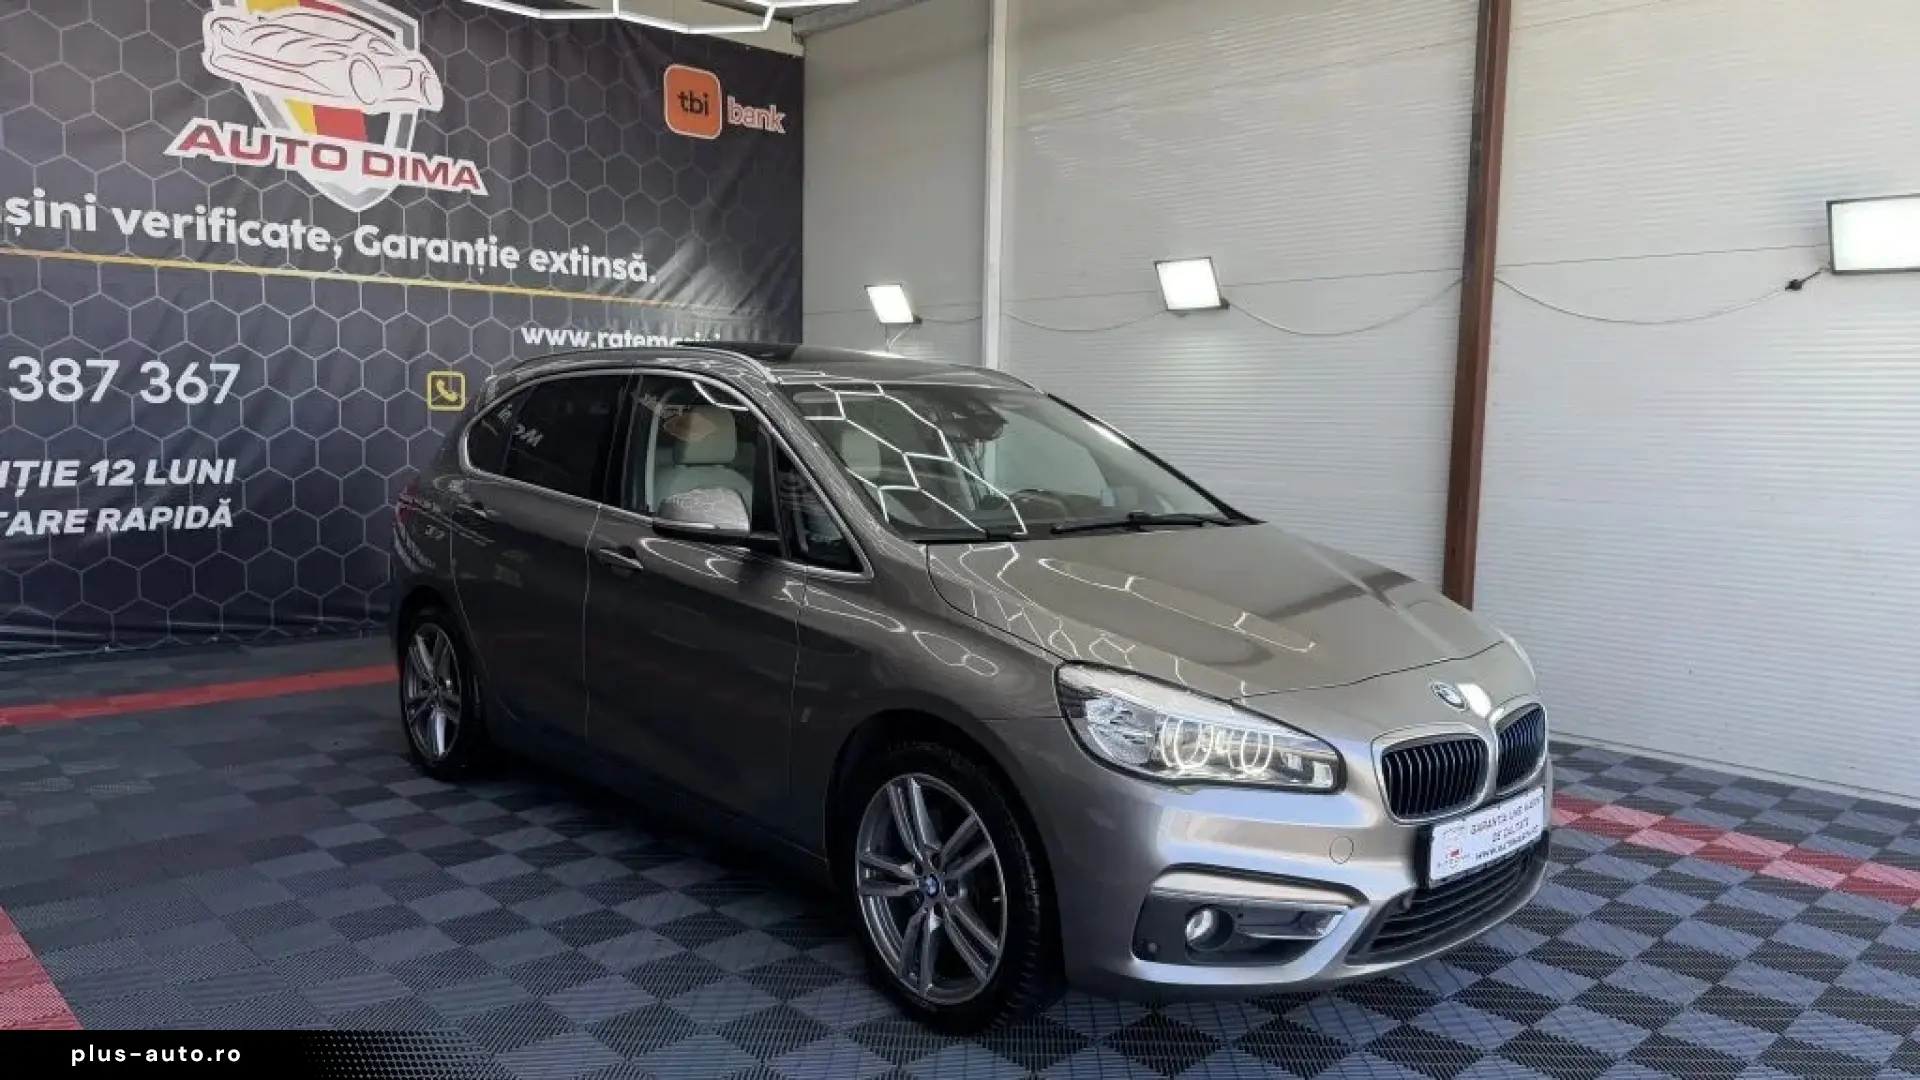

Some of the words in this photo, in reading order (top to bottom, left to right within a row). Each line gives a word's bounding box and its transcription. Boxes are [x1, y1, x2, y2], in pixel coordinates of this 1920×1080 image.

[676, 89, 710, 117] tbi
[726, 95, 787, 134] bank
[177, 123, 348, 172] AUTO
[361, 148, 481, 190] DIMA
[0, 187, 97, 236] șini
[111, 203, 342, 260] verificate,
[354, 224, 520, 276] Garanție
[528, 245, 657, 283] extinsă.
[521, 327, 721, 348] www.ratem
[8, 355, 121, 402] 387
[139, 360, 241, 405] 367
[89, 458, 136, 487] 12
[144, 458, 237, 486] LUNI
[95, 498, 234, 533] RAPIDĂ
